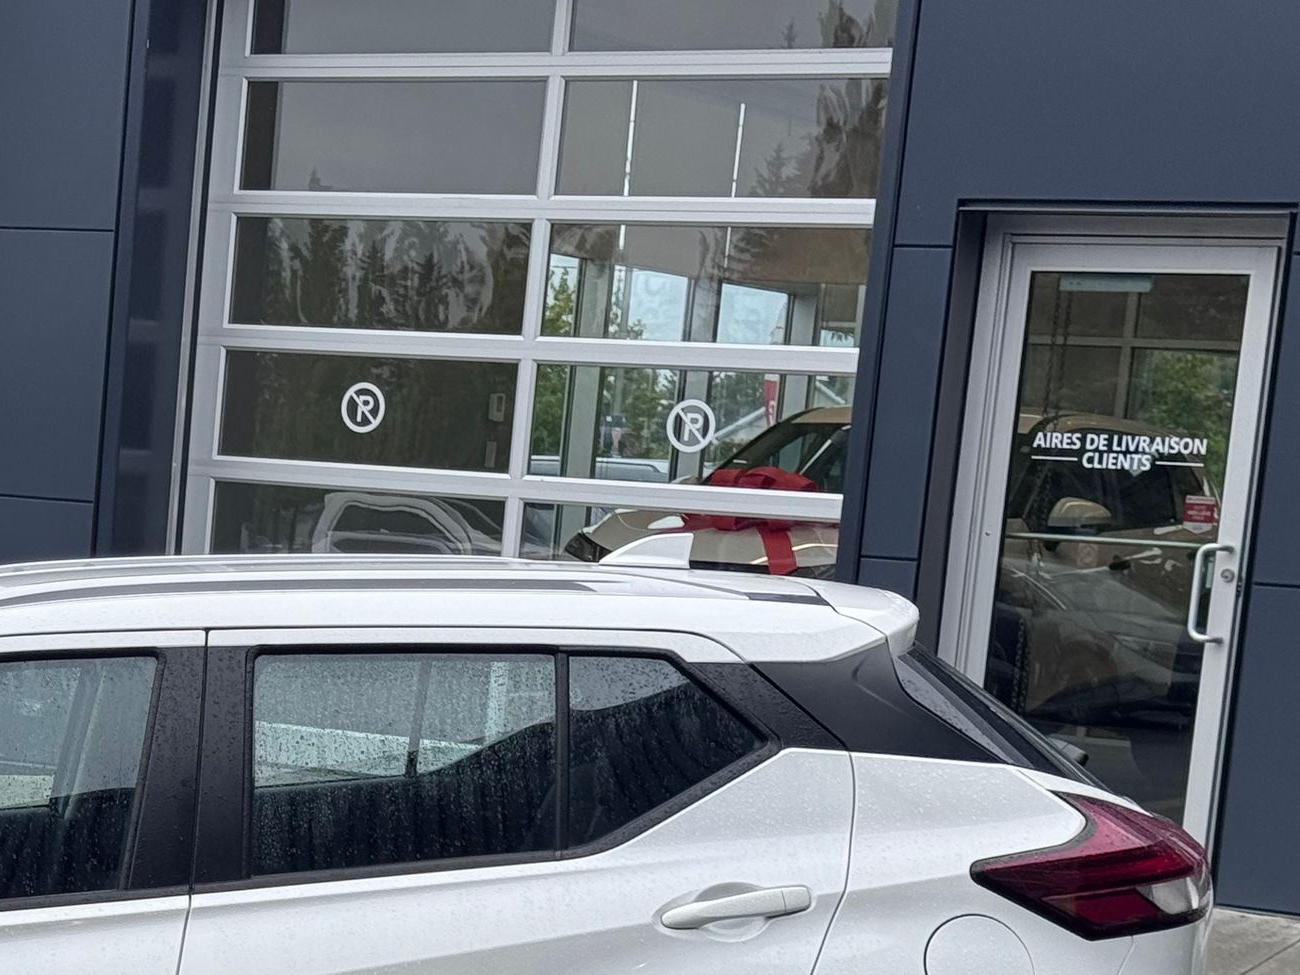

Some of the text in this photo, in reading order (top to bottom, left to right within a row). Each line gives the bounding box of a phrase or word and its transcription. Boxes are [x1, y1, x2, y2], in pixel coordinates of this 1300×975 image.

[1032, 431, 1208, 456] AIRES DE LIVRAISON
[1081, 452, 1151, 471] CLIENTS
